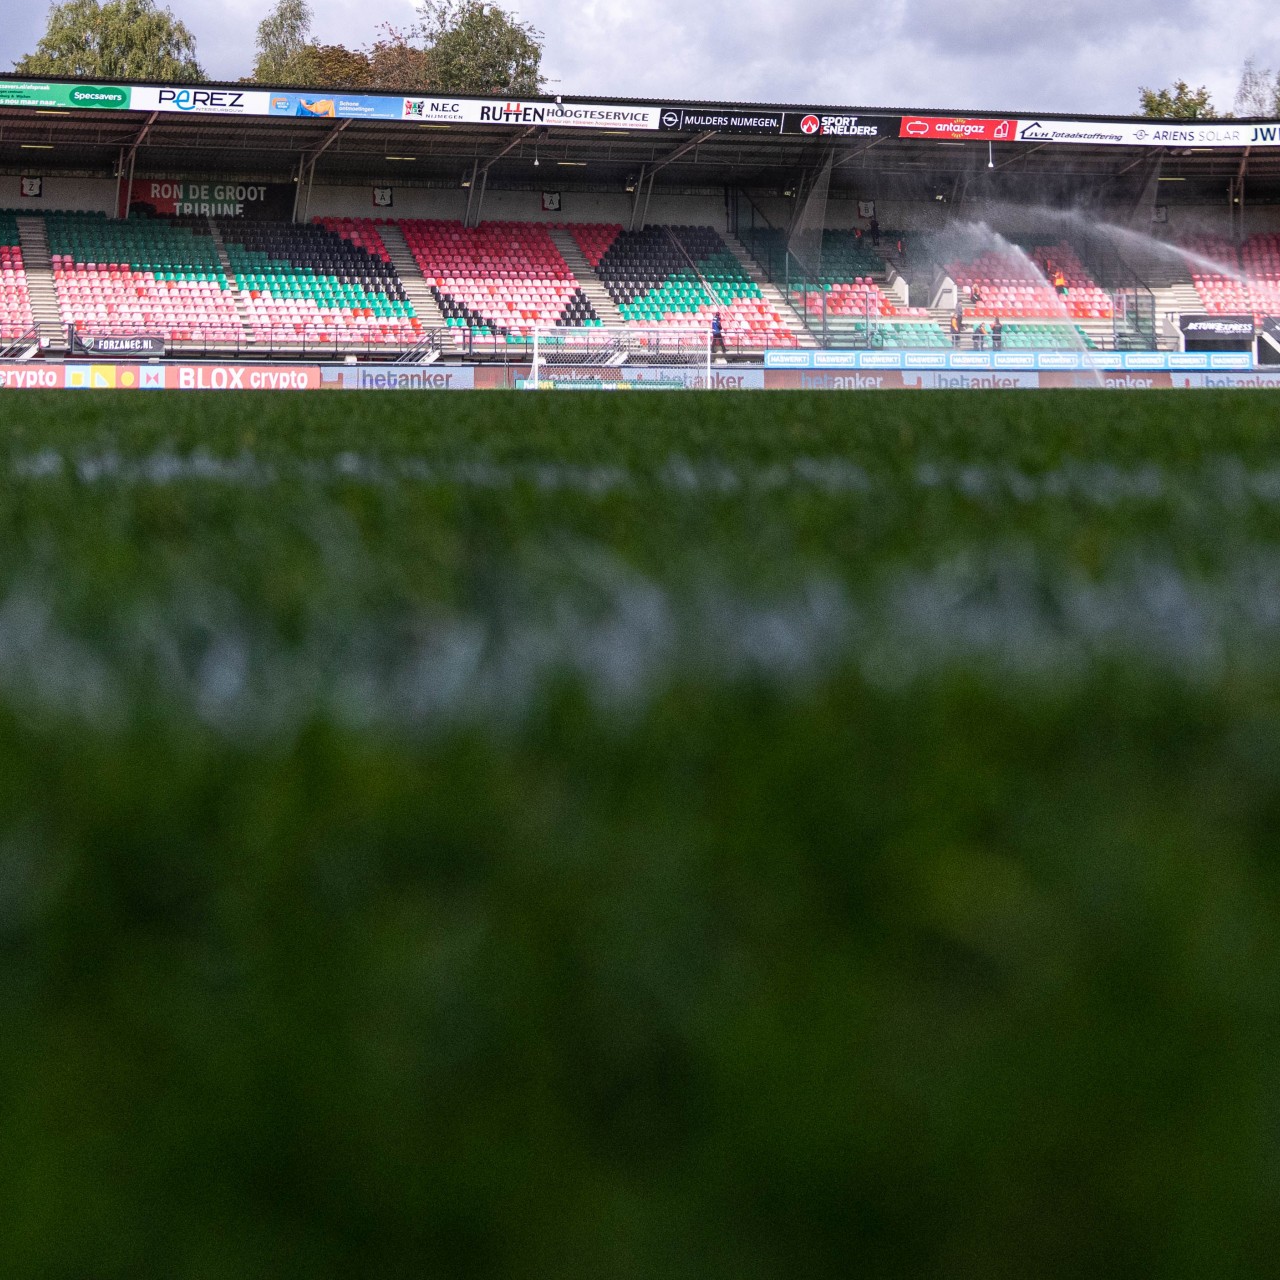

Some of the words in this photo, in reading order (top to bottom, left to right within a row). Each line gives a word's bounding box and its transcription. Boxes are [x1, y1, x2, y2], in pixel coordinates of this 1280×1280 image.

[74, 91, 122, 101] Specsavers
[480, 102, 545, 122] RUTTEN
[546, 107, 649, 121] HOOGTESERVICE
[685, 116, 728, 126] MULDERS
[821, 116, 858, 127] SPORT
[935, 123, 985, 136] antargaz
[1051, 131, 1123, 142] Totaalstoffering
[1153, 131, 1195, 141] ARIENS
[1198, 131, 1240, 141] SOLAR
[151, 182, 183, 199] RON
[189, 184, 210, 200] DE
[214, 185, 267, 201] GROOT
[98, 340, 153, 350] FORZANEC.NL
[179, 366, 245, 389] BLOX
[250, 370, 308, 389] crypto
